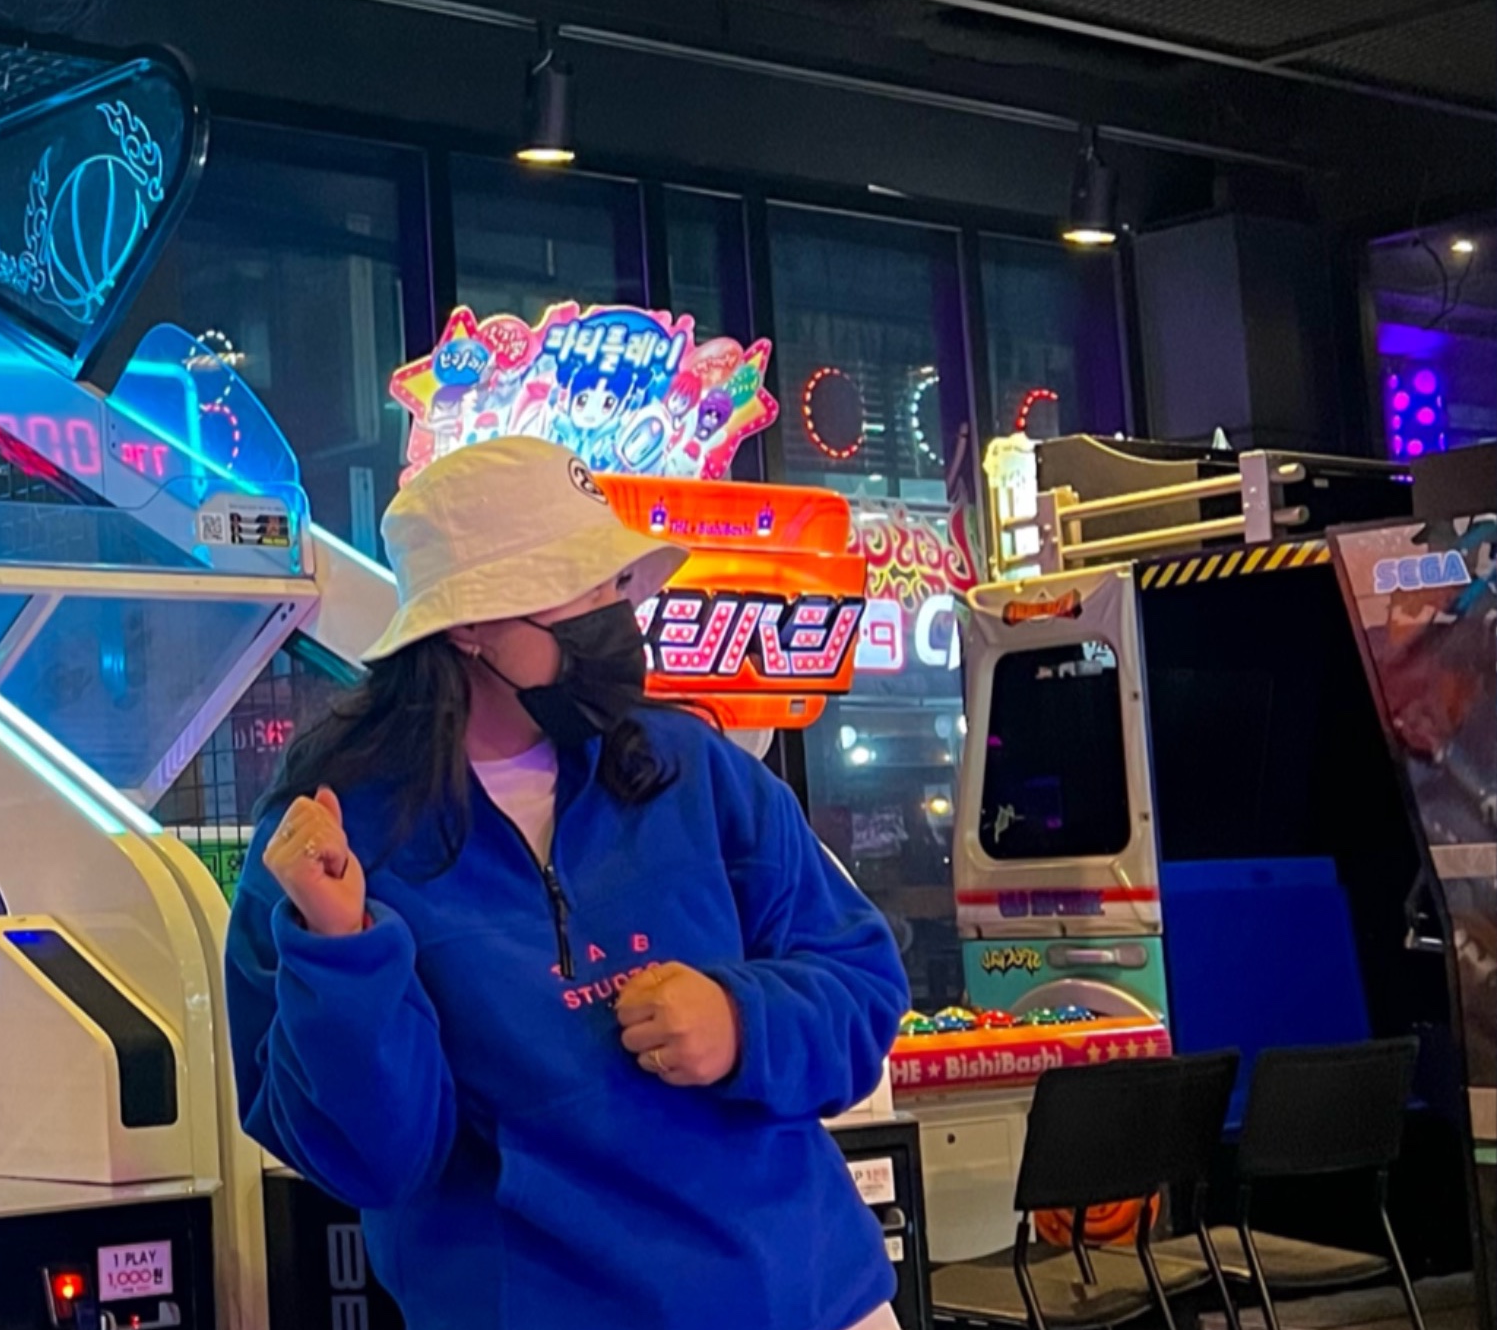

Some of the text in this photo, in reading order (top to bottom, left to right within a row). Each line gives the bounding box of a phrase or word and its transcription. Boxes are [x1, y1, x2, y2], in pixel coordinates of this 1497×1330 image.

[543, 320, 688, 375] 파티플레이
[1373, 550, 1472, 595] SEGA
[562, 960, 662, 1010] STUD
[887, 1043, 1064, 1085] HE BishiBashi
[125, 1250, 156, 1266] PLAY
